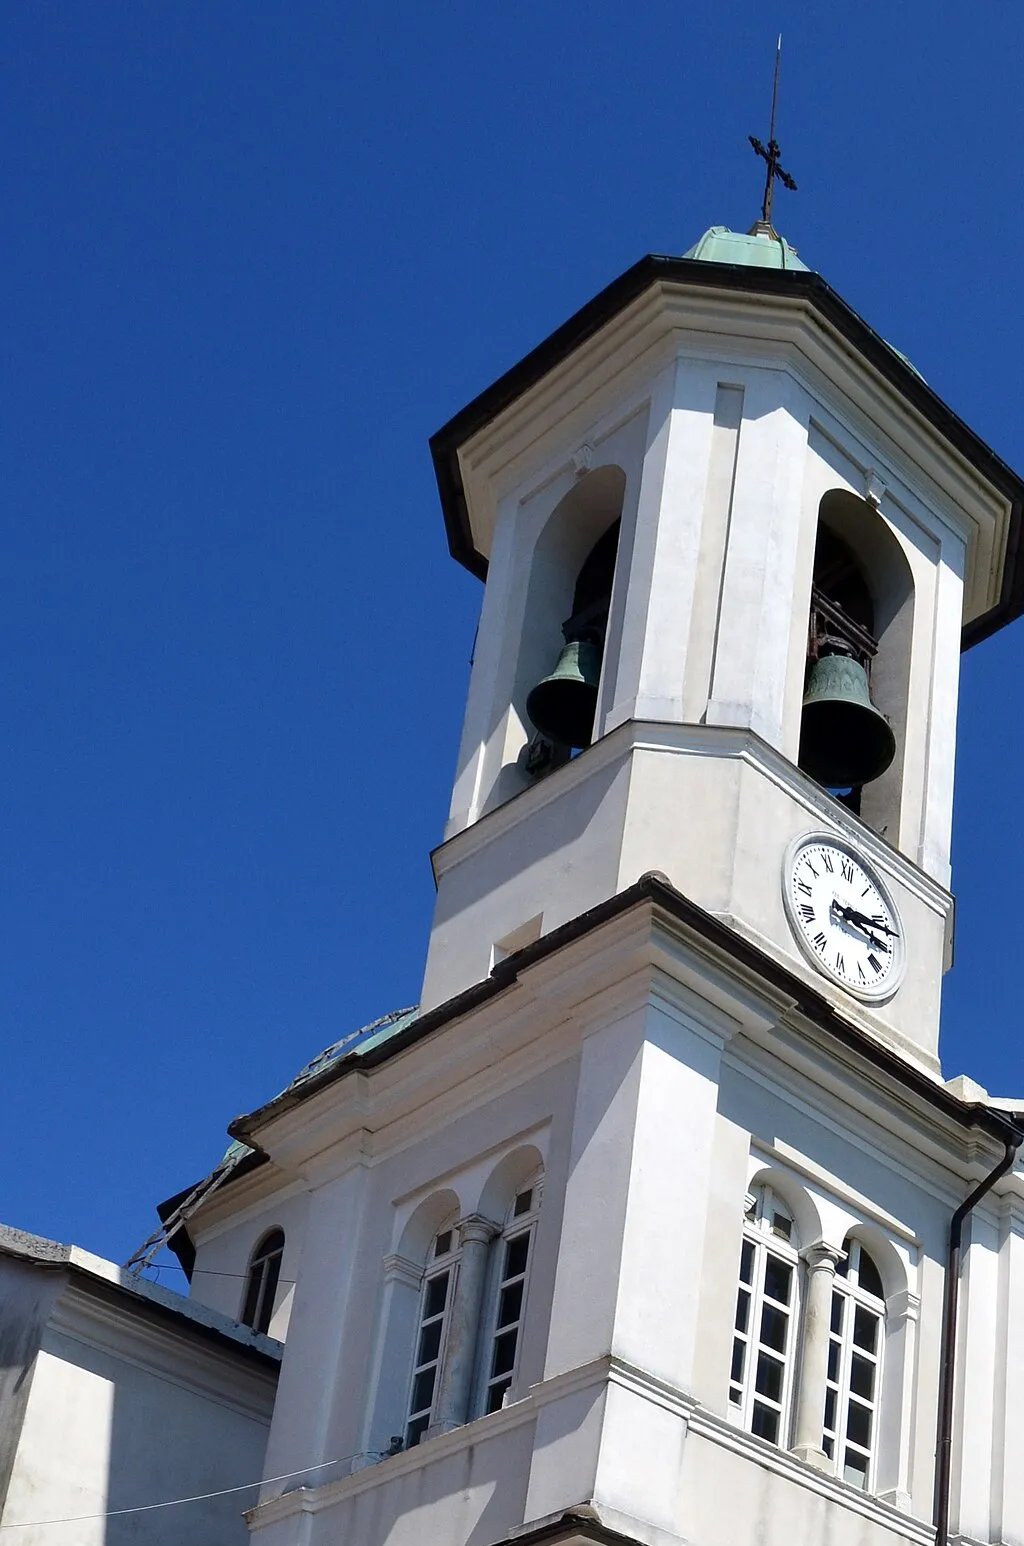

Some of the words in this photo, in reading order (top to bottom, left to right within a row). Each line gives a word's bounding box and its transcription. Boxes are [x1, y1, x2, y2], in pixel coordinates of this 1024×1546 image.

[805, 858, 820, 879] X
[821, 853, 834, 873] XI
[841, 859, 854, 884] XII
[798, 877, 813, 897] IX
[861, 887, 870, 898] I
[800, 903, 816, 923] VIII
[813, 931, 828, 952] VII
[836, 952, 846, 973] VI
[857, 960, 866, 980] V
[867, 953, 883, 974] IIII
